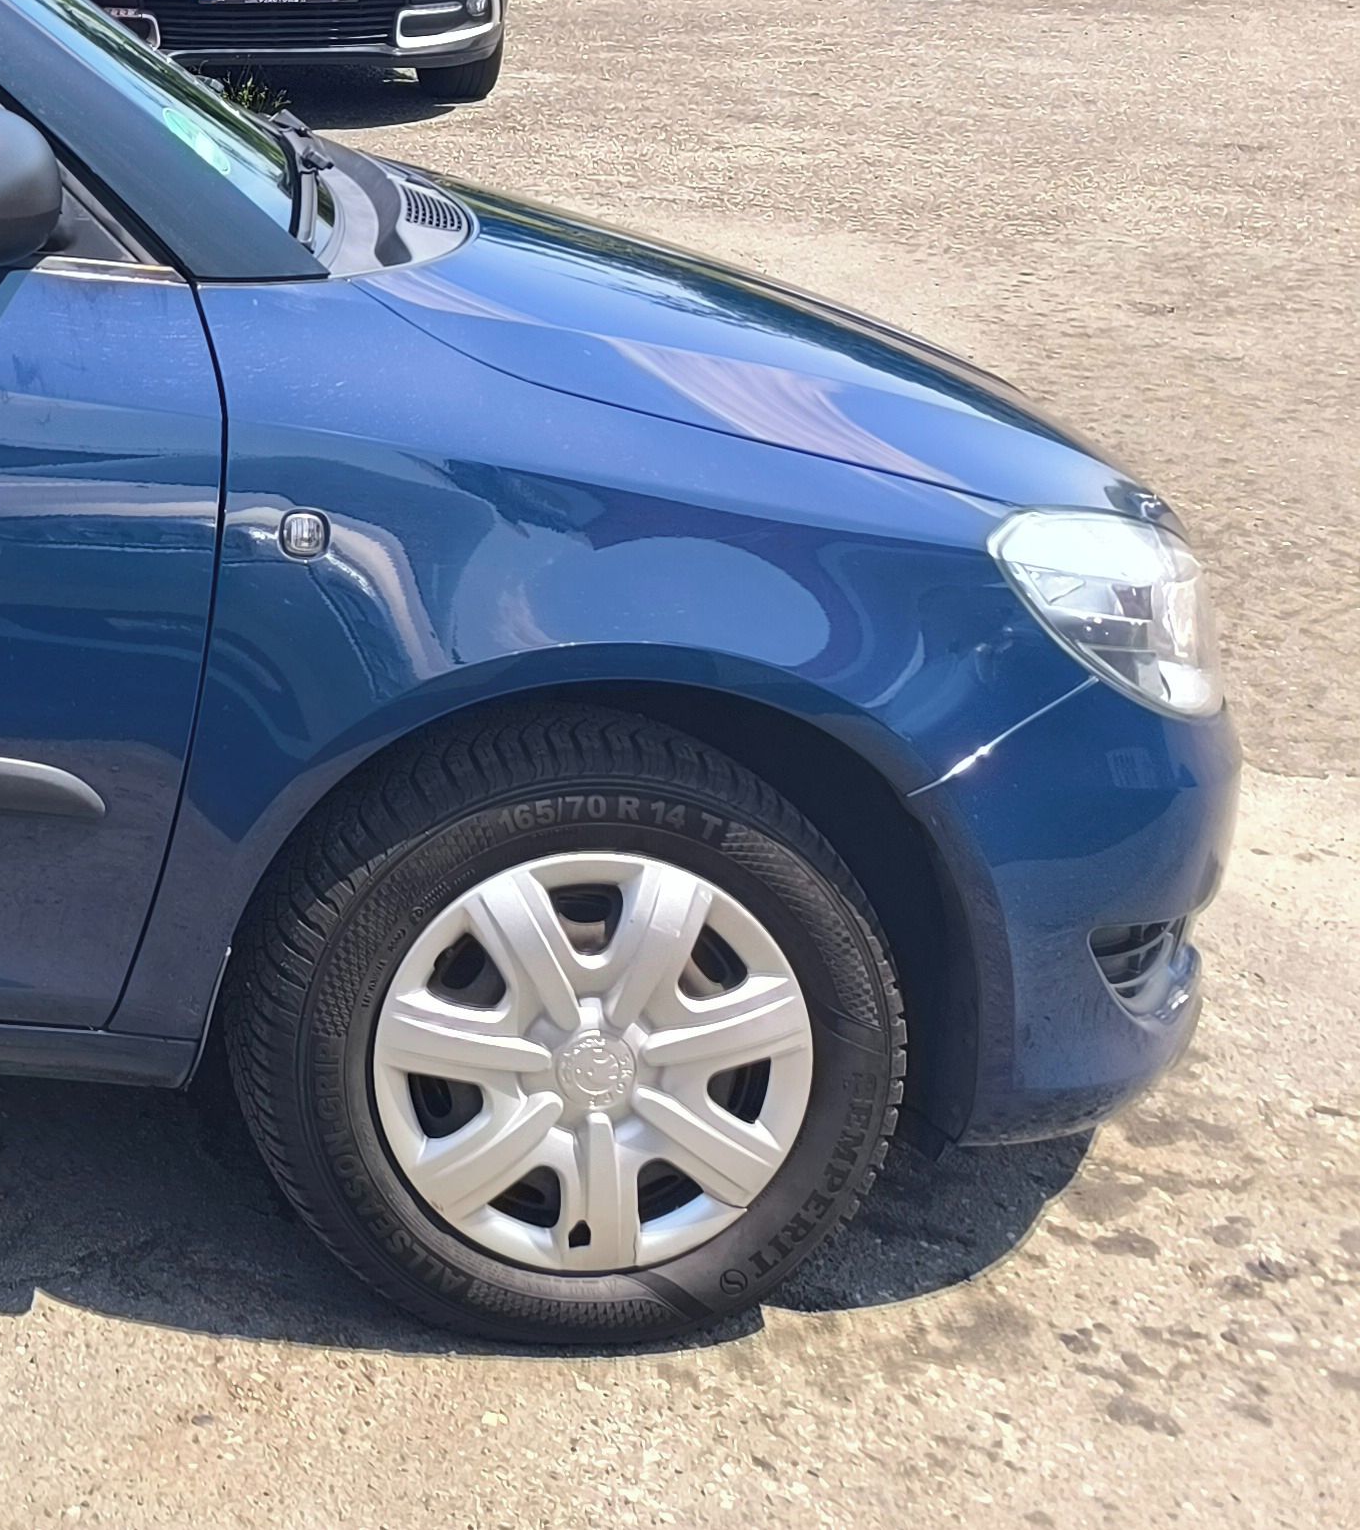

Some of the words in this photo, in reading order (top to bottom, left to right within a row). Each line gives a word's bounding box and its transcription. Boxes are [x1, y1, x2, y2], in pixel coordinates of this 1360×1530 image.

[496, 794, 608, 835] 165/70
[617, 794, 641, 821] R
[649, 799, 686, 829] 14
[700, 811, 724, 841] T
[748, 1072, 877, 1278] SEMPERIT
